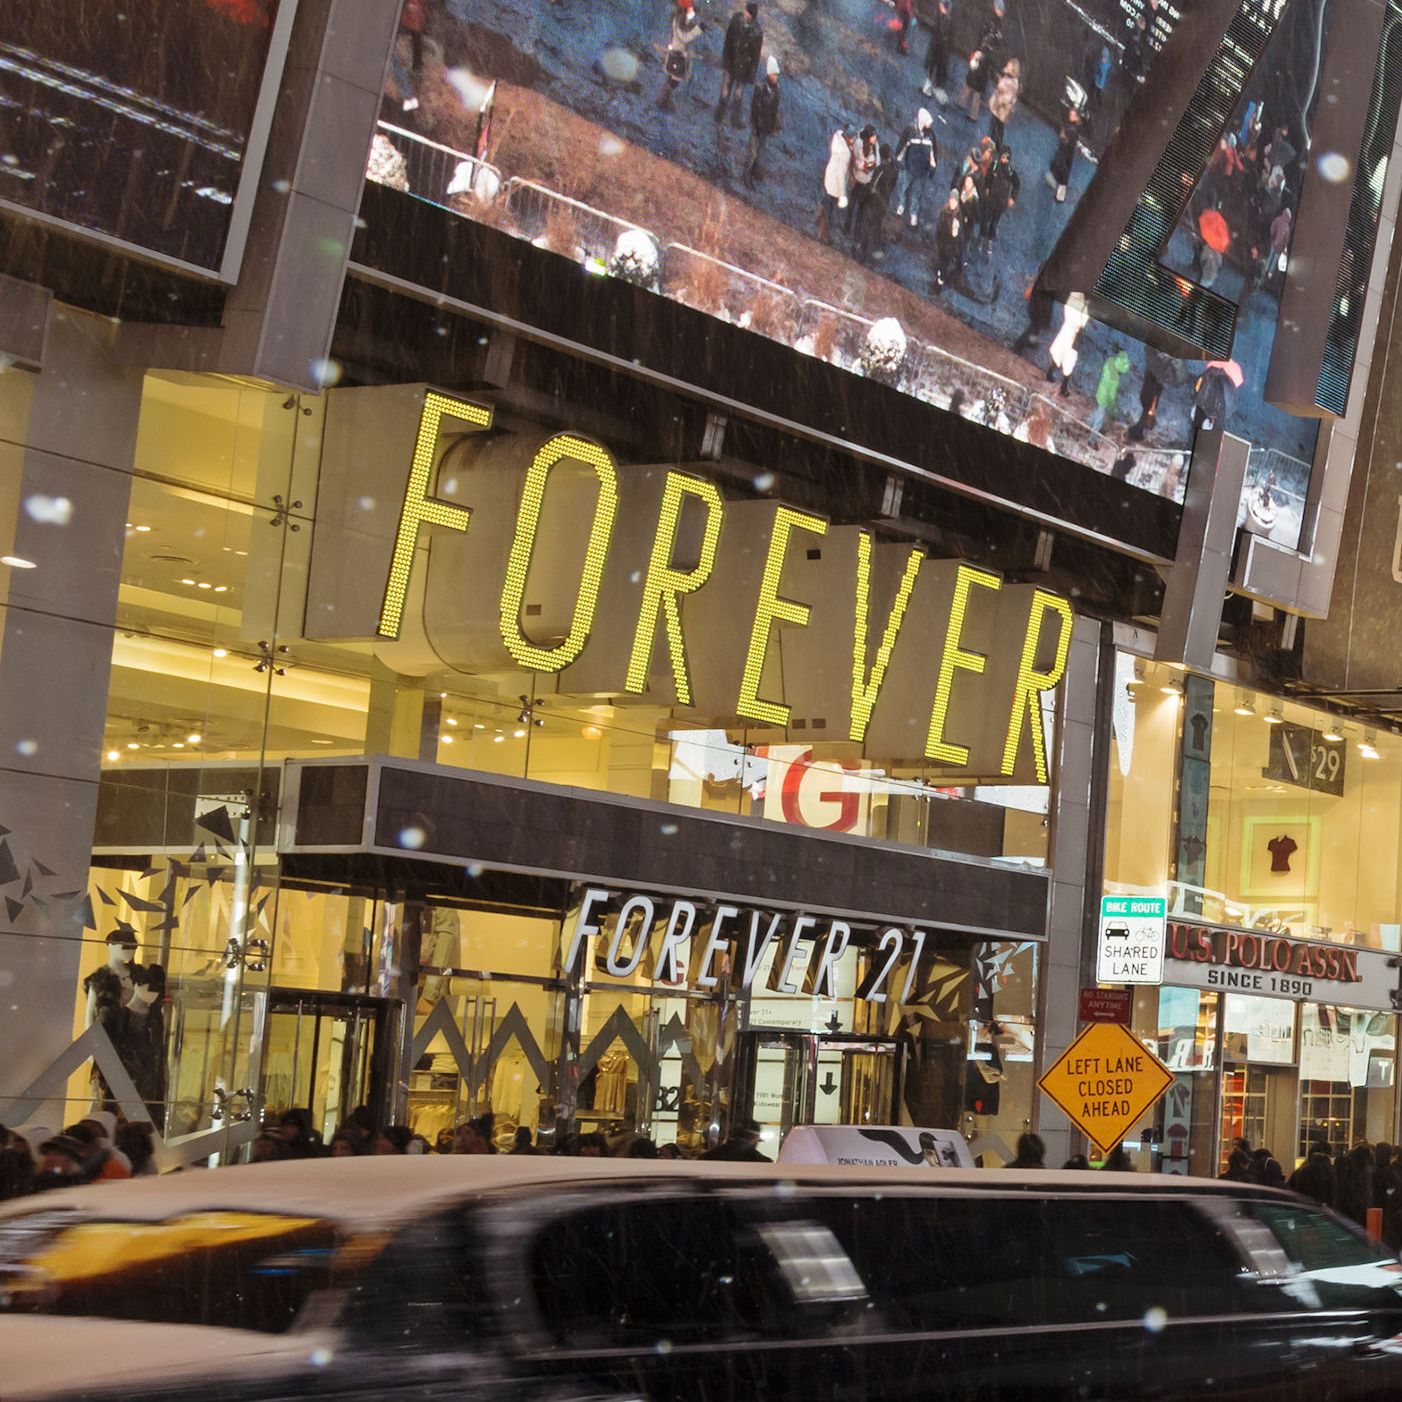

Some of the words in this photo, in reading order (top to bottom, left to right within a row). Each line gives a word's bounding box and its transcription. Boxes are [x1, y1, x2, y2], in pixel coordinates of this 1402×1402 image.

[376, 388, 1075, 786] FOREVER
[1311, 744, 1341, 783] $29
[1105, 901, 1129, 914] BIKE
[1130, 901, 1162, 915] ROUTE
[564, 889, 851, 999] FOREVER
[868, 927, 927, 1004] 21
[1104, 945, 1158, 960] SHARED
[1171, 923, 1217, 964] U.S.
[1223, 930, 1292, 973] POLO
[1296, 945, 1363, 983] ASSN.
[1112, 963, 1148, 977] LANE
[1207, 969, 1263, 990] SINCE
[1270, 978, 1313, 996] 1890
[1087, 1000, 1123, 1011] ANYTIME
[1066, 1058, 1101, 1075] LEFT
[1105, 1056, 1144, 1074] LANE
[1077, 1079, 1134, 1097] CLOSED
[1081, 1100, 1131, 1119] AHEAD
